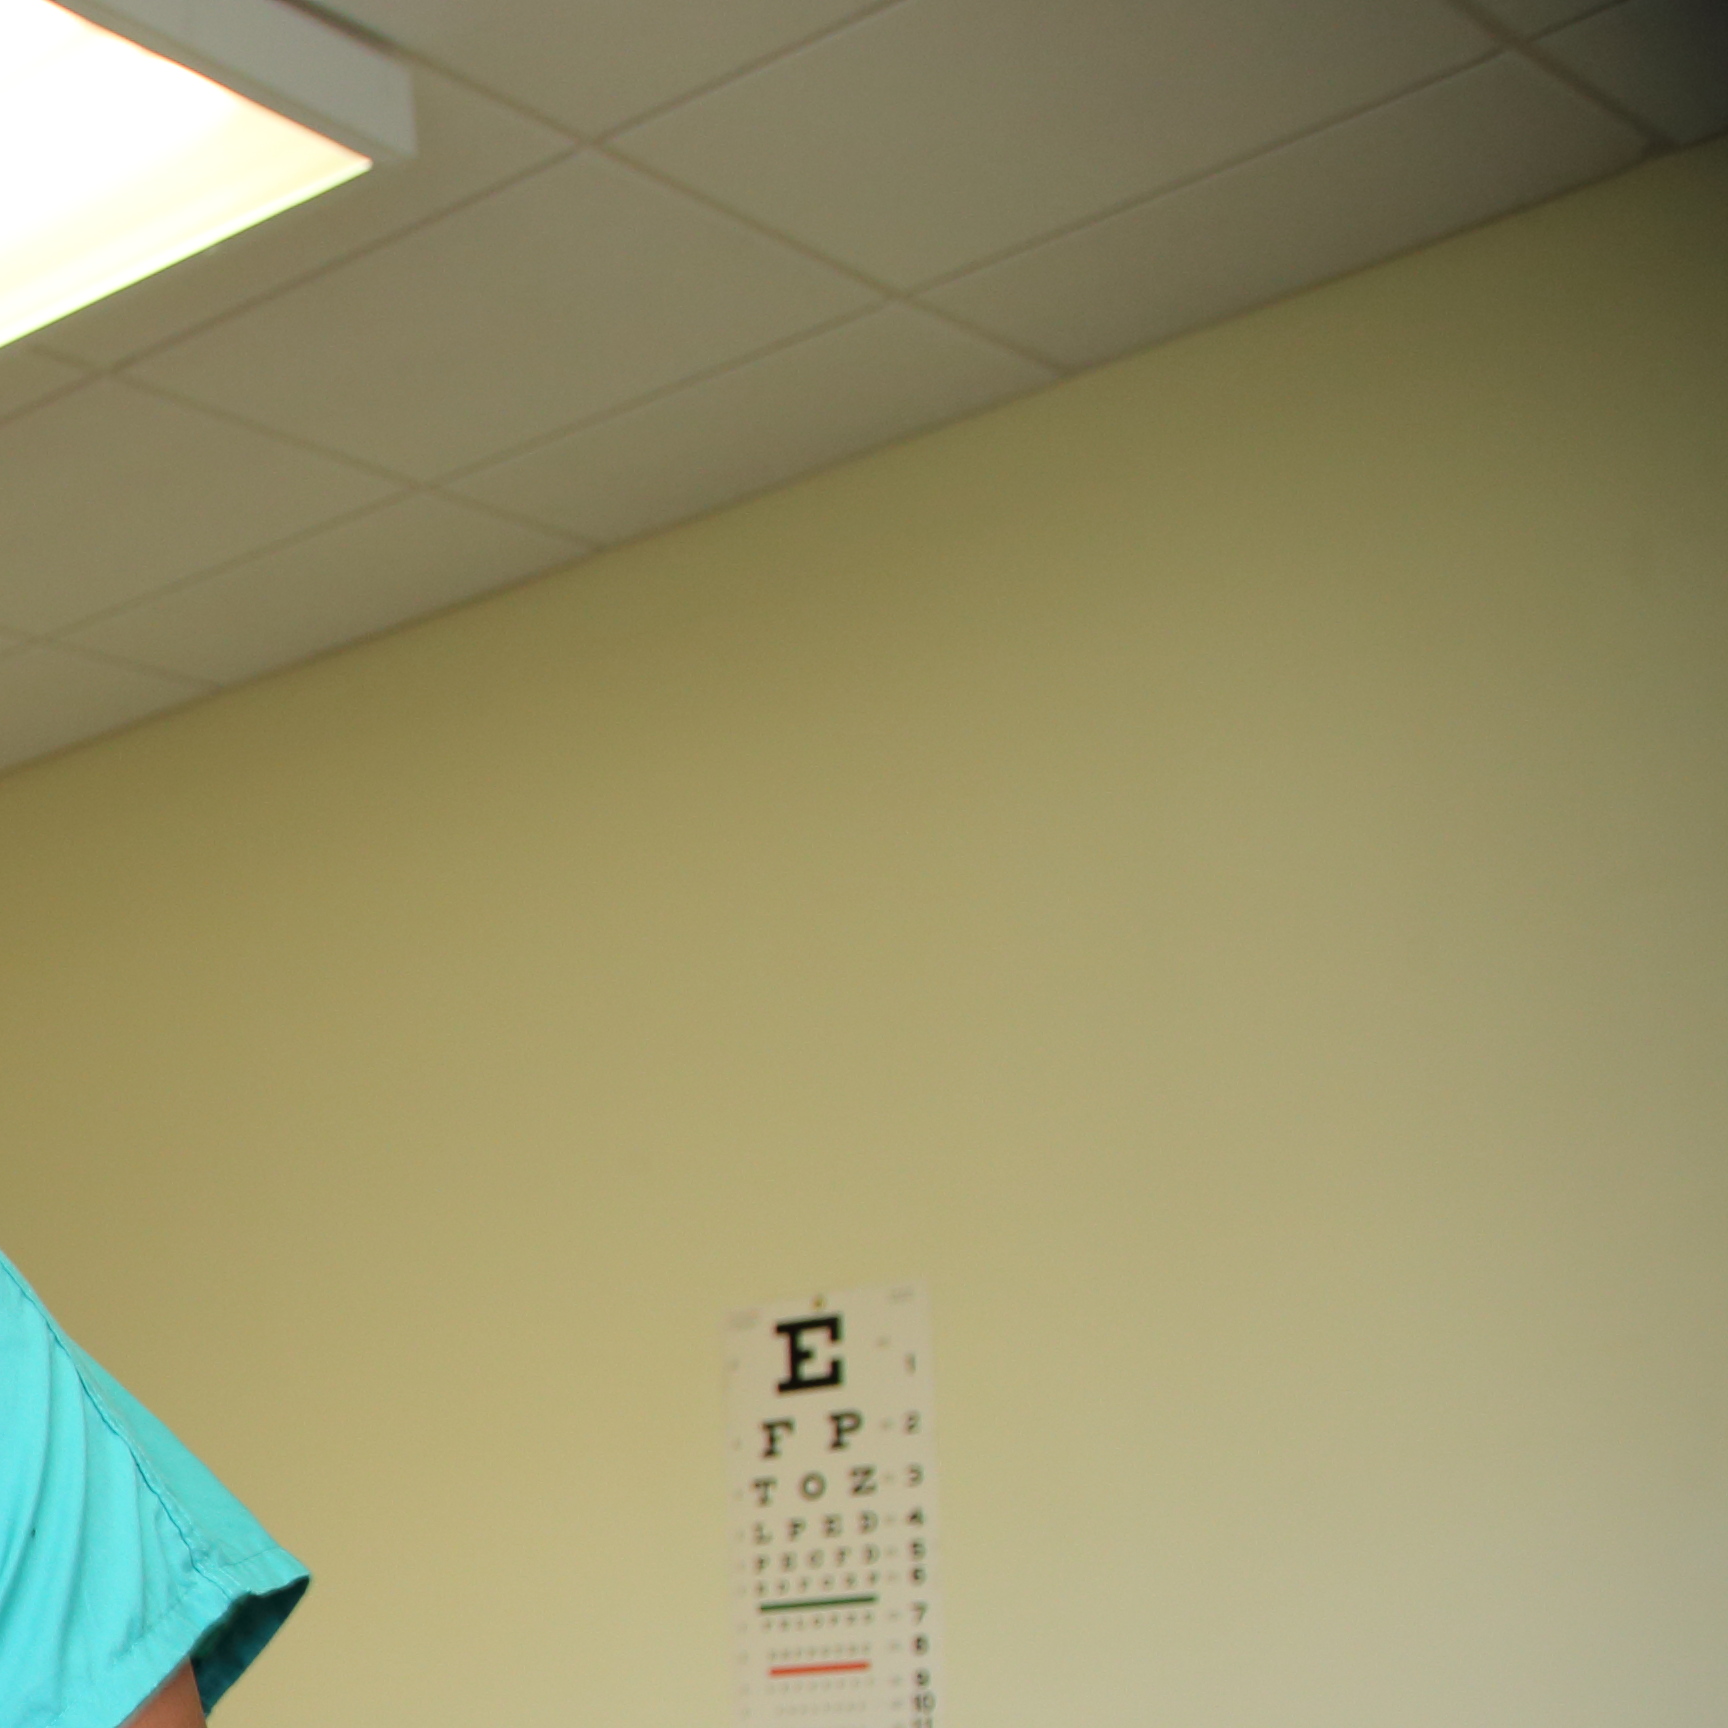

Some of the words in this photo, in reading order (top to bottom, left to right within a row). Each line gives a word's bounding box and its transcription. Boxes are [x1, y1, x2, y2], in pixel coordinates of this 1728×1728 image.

[775, 1314, 842, 1393] E
[761, 1417, 794, 1458] F
[829, 1409, 863, 1449] P
[752, 1476, 777, 1506] T
[800, 1471, 826, 1501] O
[849, 1465, 877, 1496] Z
